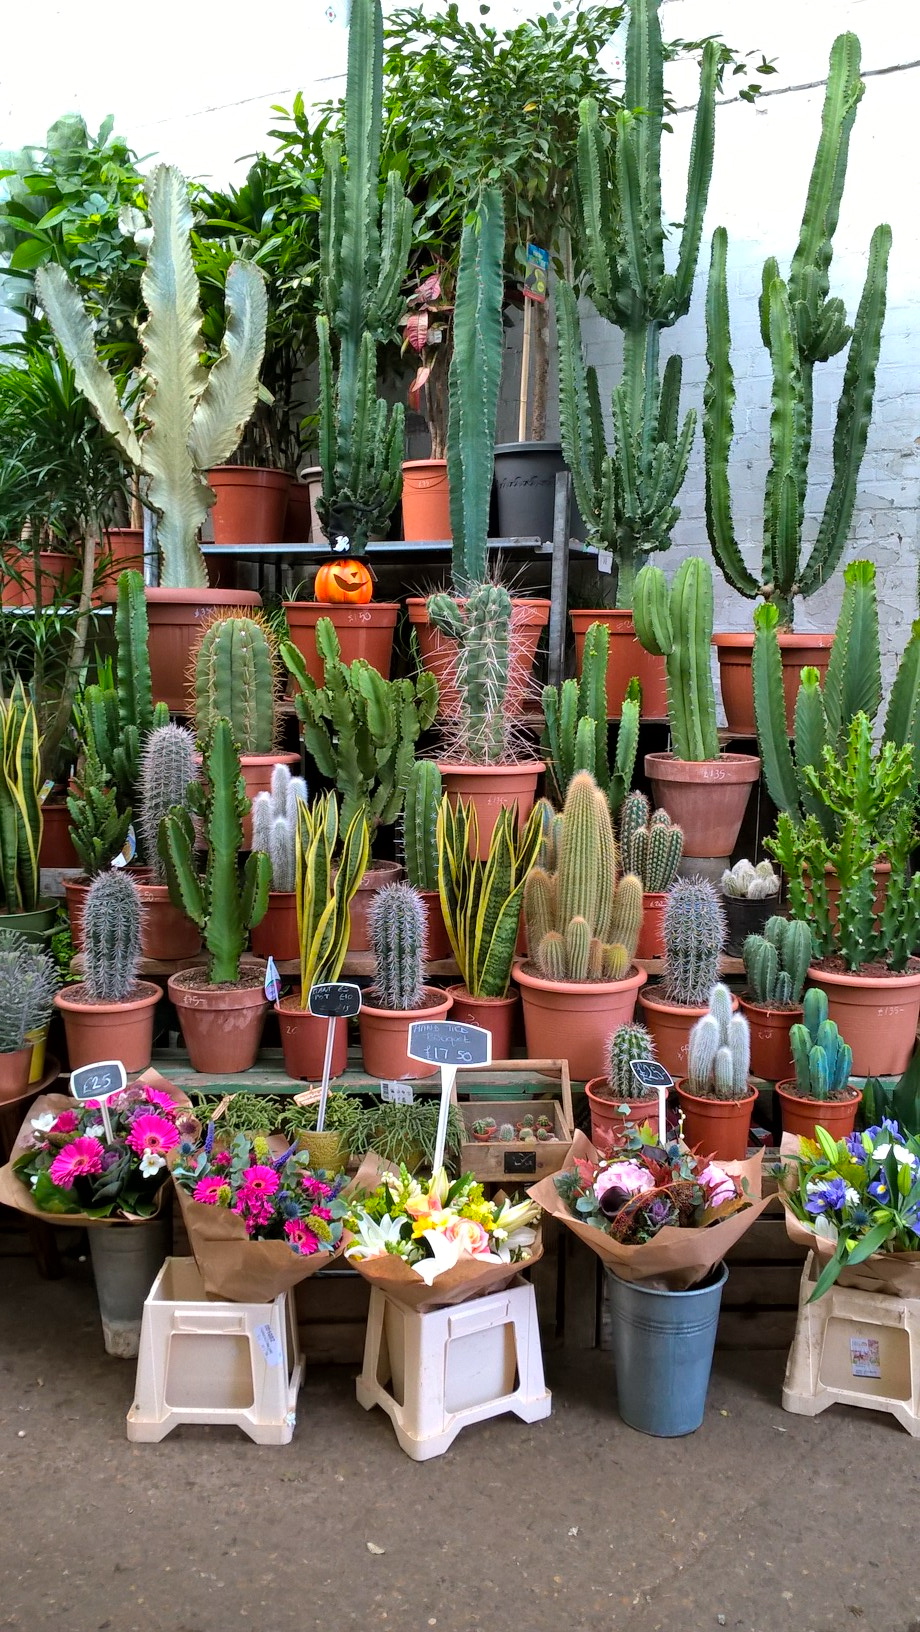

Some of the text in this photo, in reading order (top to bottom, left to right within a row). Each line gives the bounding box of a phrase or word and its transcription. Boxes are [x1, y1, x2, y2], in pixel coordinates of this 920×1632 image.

[413, 1024, 469, 1034] HAND TIED
[82, 1072, 112, 1094] £25
